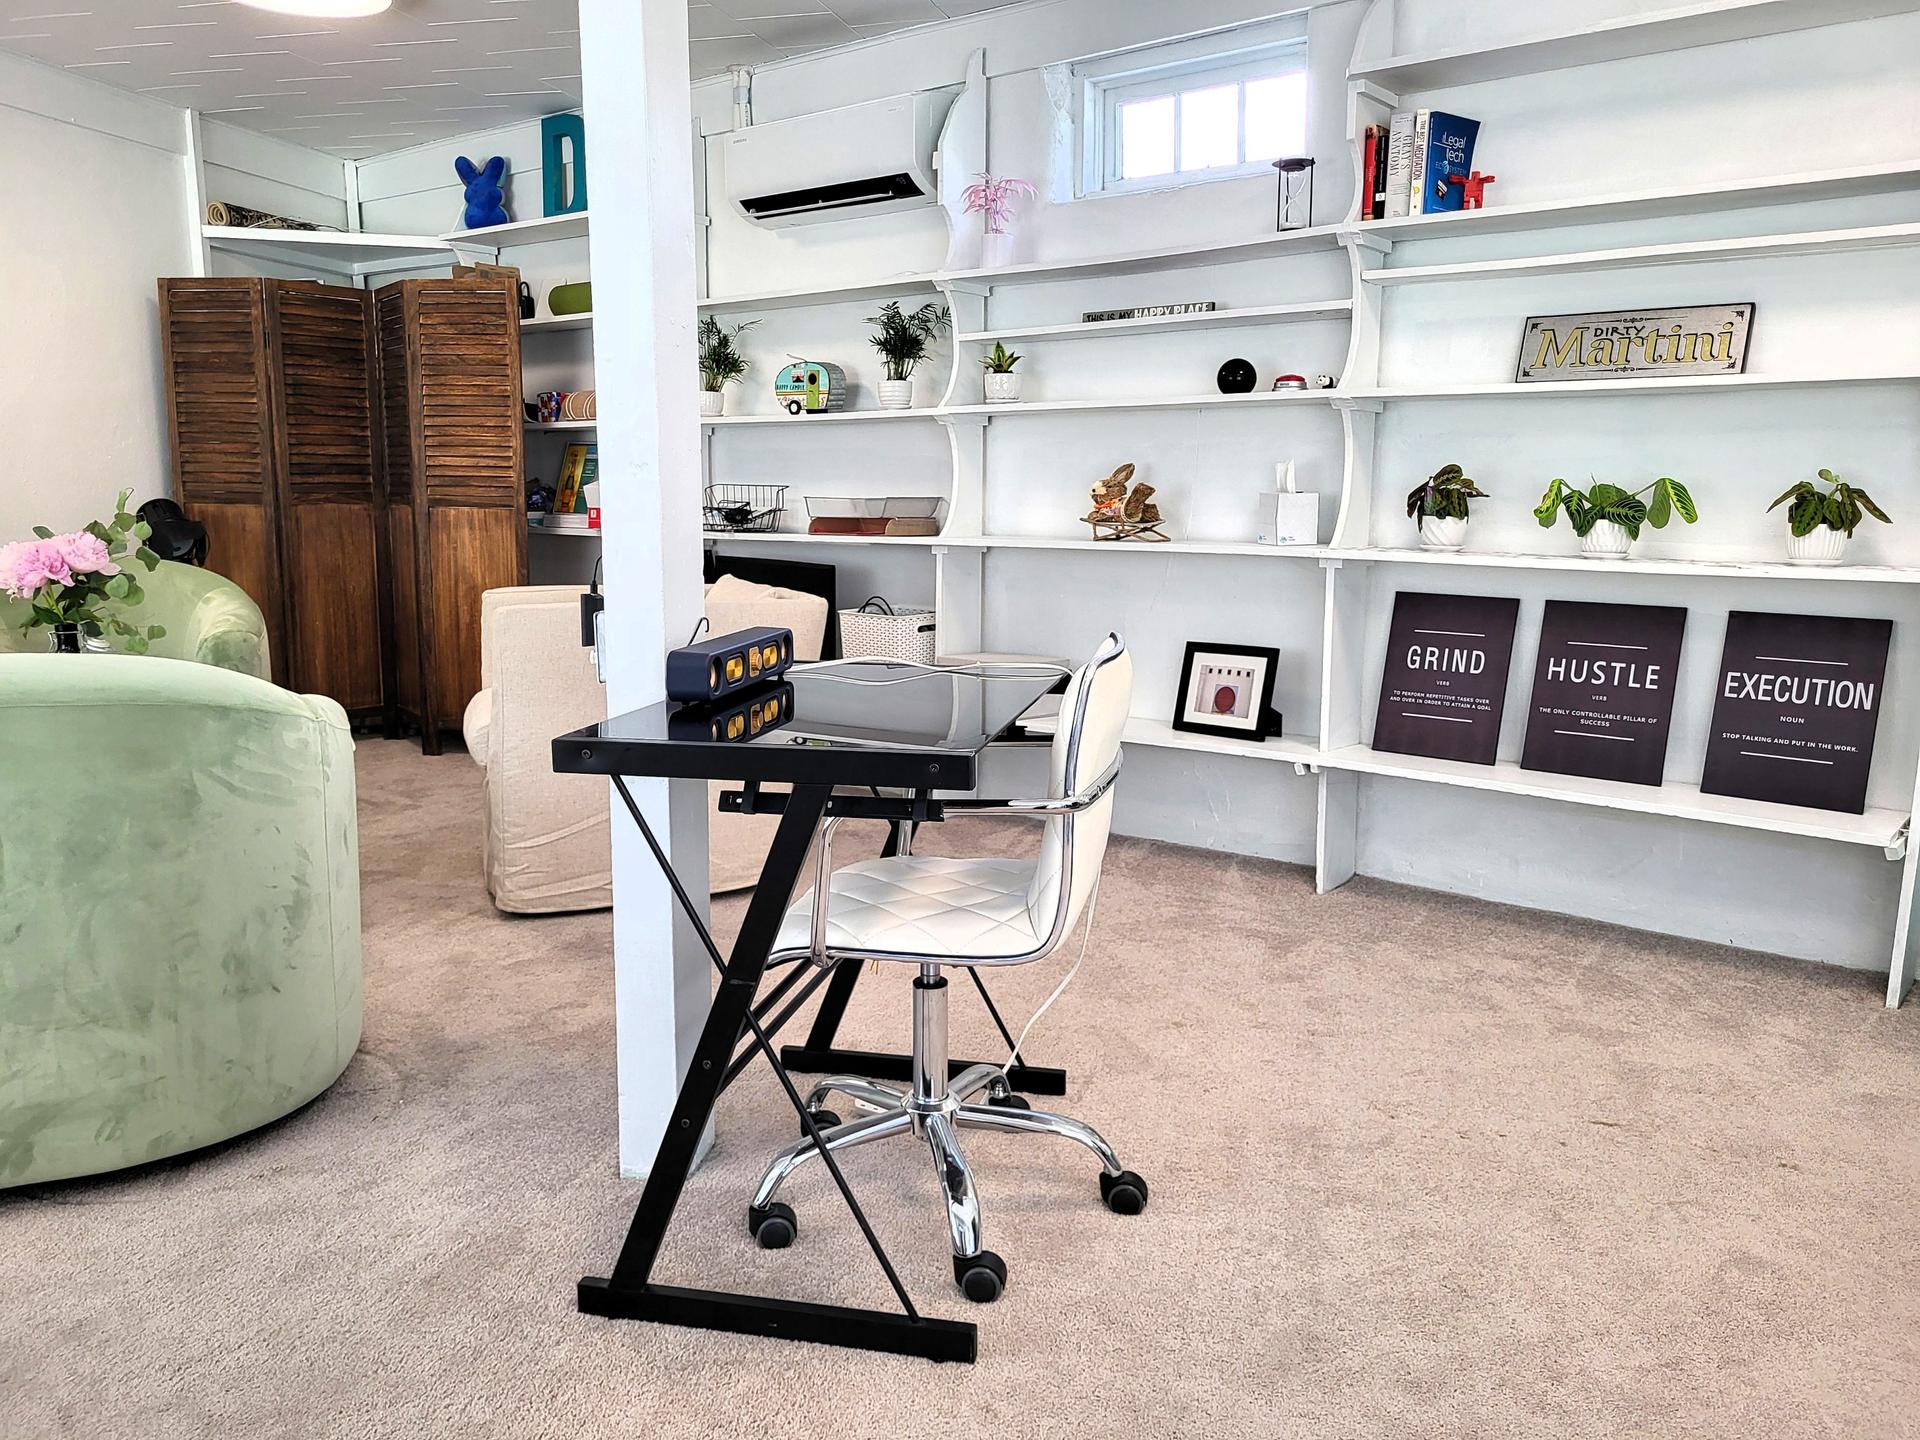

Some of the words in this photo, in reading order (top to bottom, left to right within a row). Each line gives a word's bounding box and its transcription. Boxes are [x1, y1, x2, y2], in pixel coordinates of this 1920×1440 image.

[1442, 132, 1466, 149] Legal
[1390, 130, 1402, 177] ANATOMY
[1401, 135, 1414, 170] GRAY'S
[1446, 146, 1464, 164] Tech
[1412, 144, 1424, 181] MEDITATION
[1107, 313, 1116, 321] IS
[1119, 311, 1132, 320] MY
[1134, 306, 1171, 318] HAPPY
[1174, 302, 1209, 315] PLACE
[1594, 326, 1646, 338] DIRTY
[1529, 321, 1738, 370] Martini
[1406, 645, 1486, 674] GRIND
[1547, 657, 1660, 690] HUSTLE
[1724, 671, 1874, 711] EXECUTION
[1572, 710, 1621, 721] CONTROLLABLE
[1580, 718, 1610, 727] SUCCESS
[1780, 716, 1805, 724] NOUN
[1742, 734, 1772, 743] TALKING
